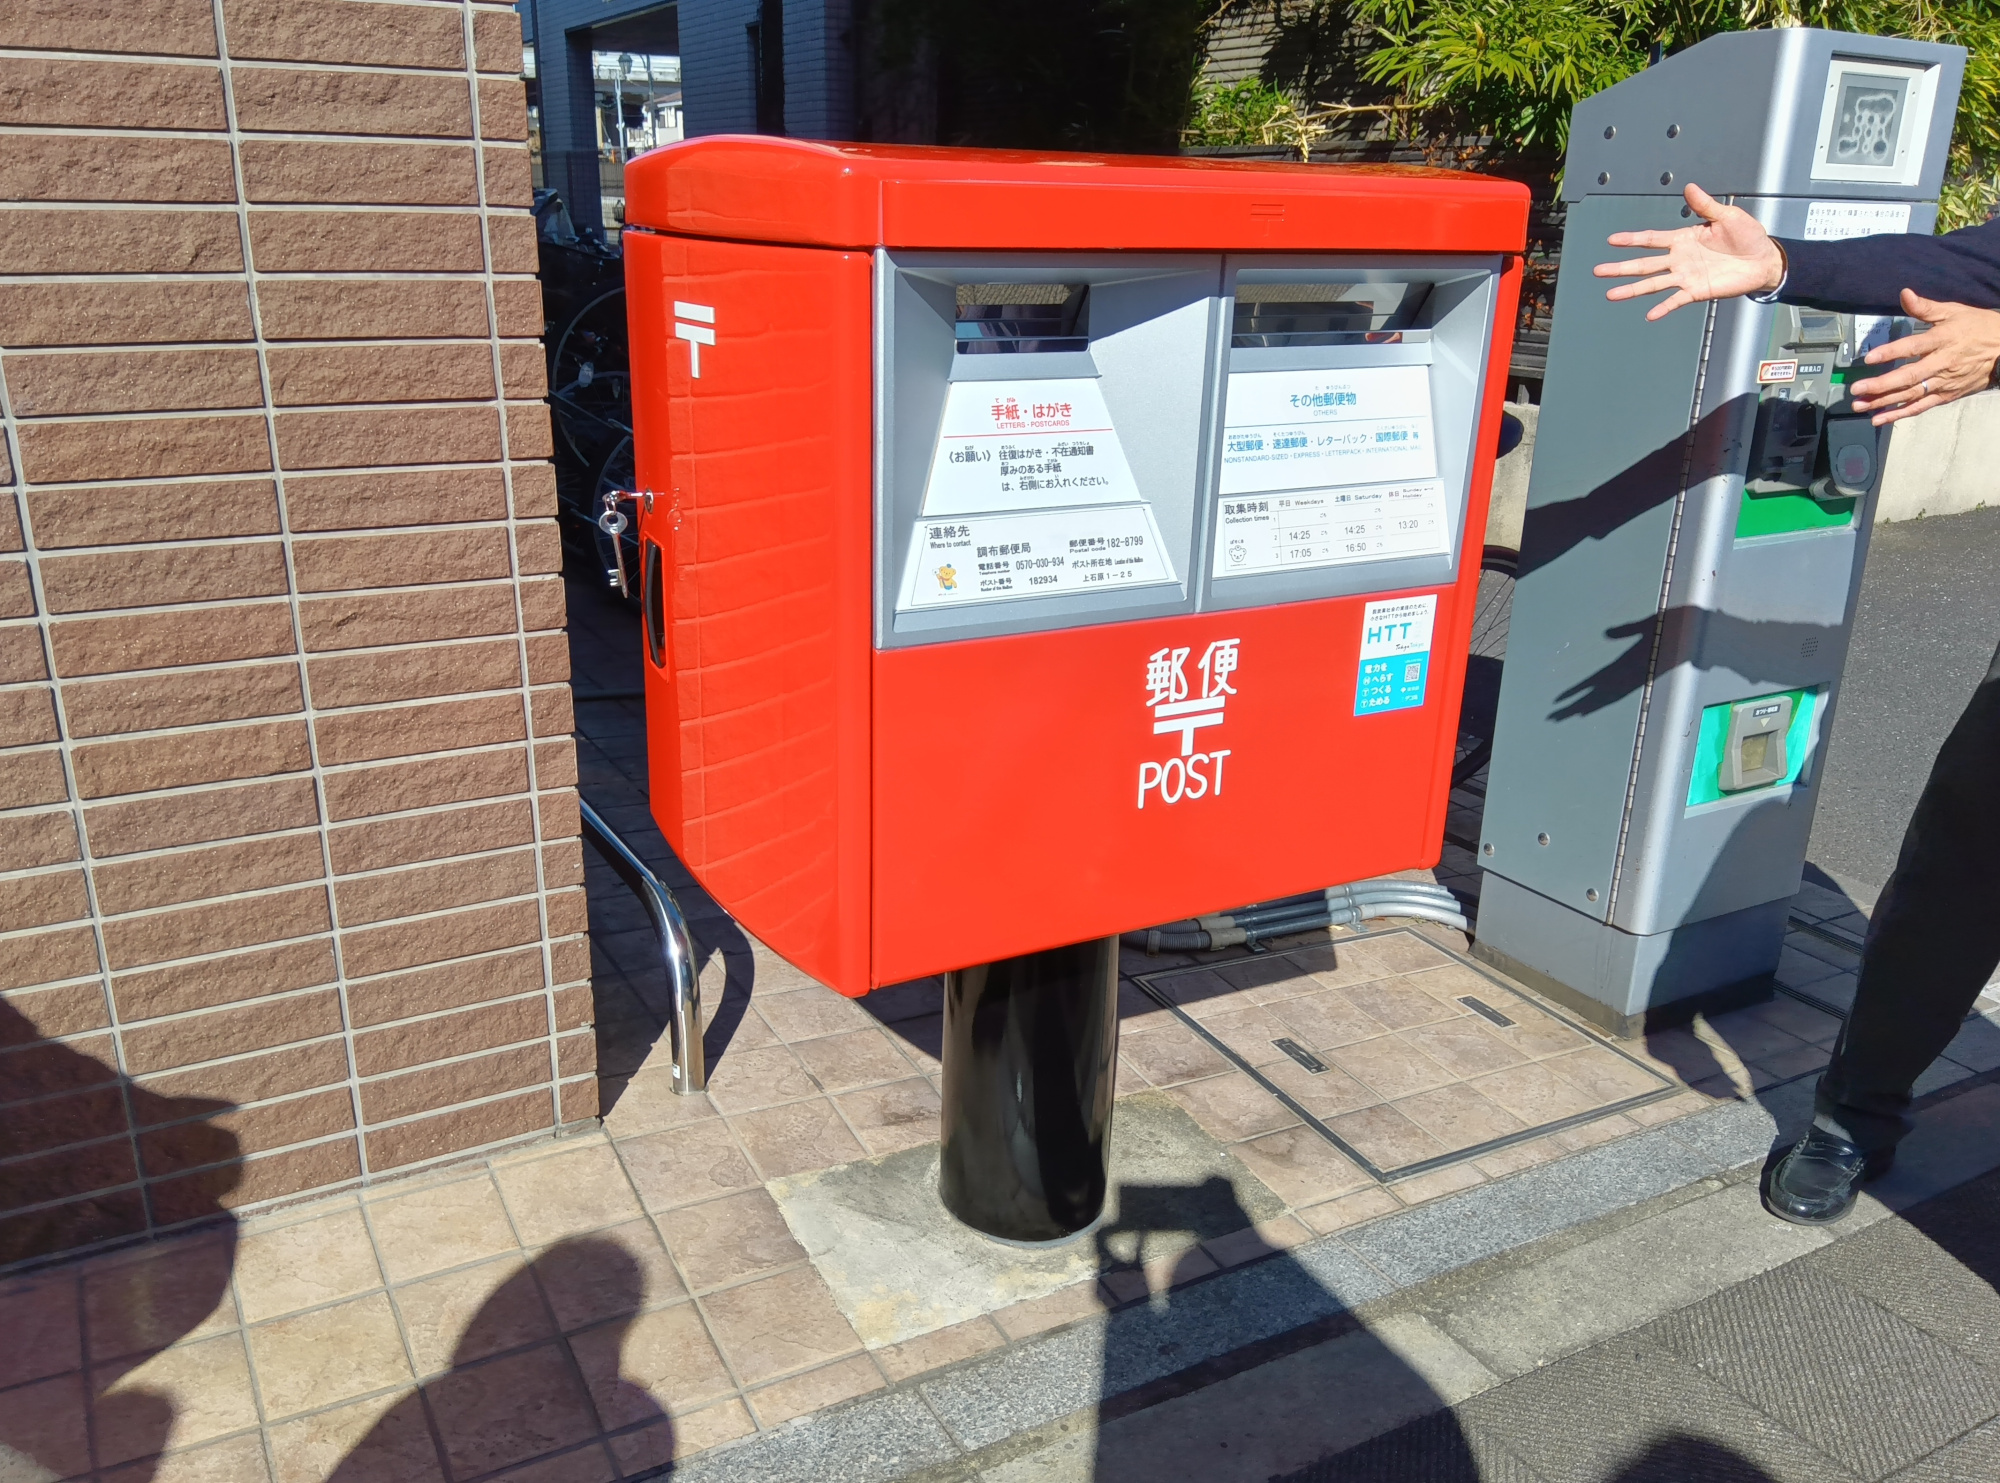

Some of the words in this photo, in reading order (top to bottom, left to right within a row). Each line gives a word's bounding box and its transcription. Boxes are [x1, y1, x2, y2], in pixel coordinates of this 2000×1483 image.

[1290, 392, 1356, 407] その他郵便物
[991, 403, 1072, 421] 手紙・はがき
[1313, 409, 1338, 417] OTHERS
[999, 446, 1094, 460] 往復はがき・不在通知書
[1000, 463, 1062, 476] 厚みのある手紙
[1002, 477, 1109, 492] は、右側にお入れください。
[1224, 501, 1269, 515] 取集時刻
[1344, 524, 1366, 534] 14:25
[1398, 520, 1418, 530] 13:20
[928, 525, 970, 540] 連絡先
[1288, 530, 1310, 540] 14:25
[953, 540, 971, 548] contact
[1069, 537, 1105, 547] 郵便番号
[1106, 536, 1144, 548] 182-8799
[1346, 542, 1366, 552] 16:50
[977, 542, 1031, 558] 調布郵便局
[1290, 548, 1312, 558] 17:05
[978, 561, 1009, 570] 電話番号
[1016, 556, 1064, 570] 0570-030-934
[1072, 557, 1112, 569] ポスト所在地
[980, 578, 1012, 586] ポスト番号
[1029, 575, 1058, 585] 182934
[1367, 622, 1412, 644] HTT
[1146, 638, 1240, 707] 郵便
[1137, 749, 1232, 810] POST
